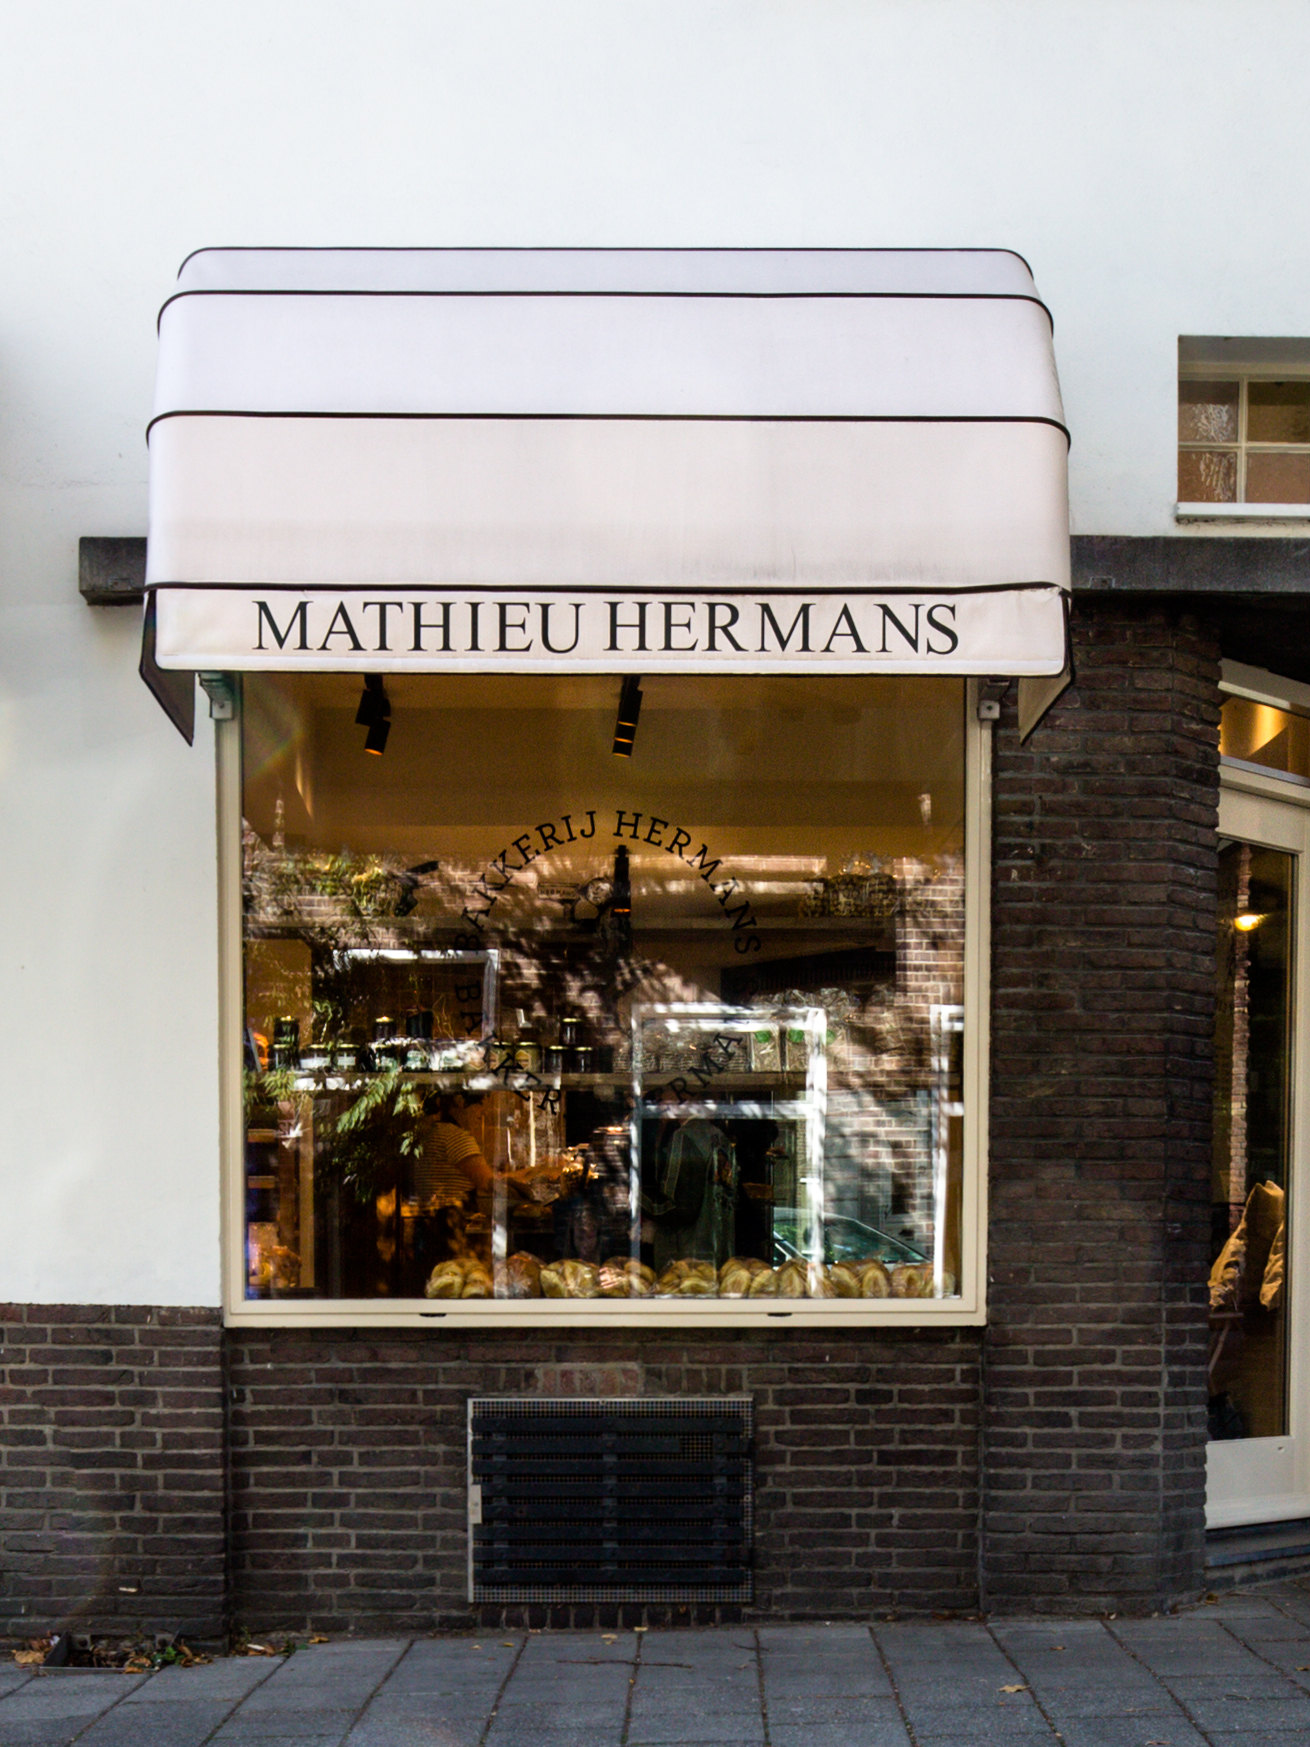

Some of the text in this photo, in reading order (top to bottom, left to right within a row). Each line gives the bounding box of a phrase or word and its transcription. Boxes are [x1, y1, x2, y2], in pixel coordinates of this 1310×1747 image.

[251, 600, 960, 655] MATHIEU HERMANS
[455, 810, 762, 956] BAKKERIJ HERMANS
